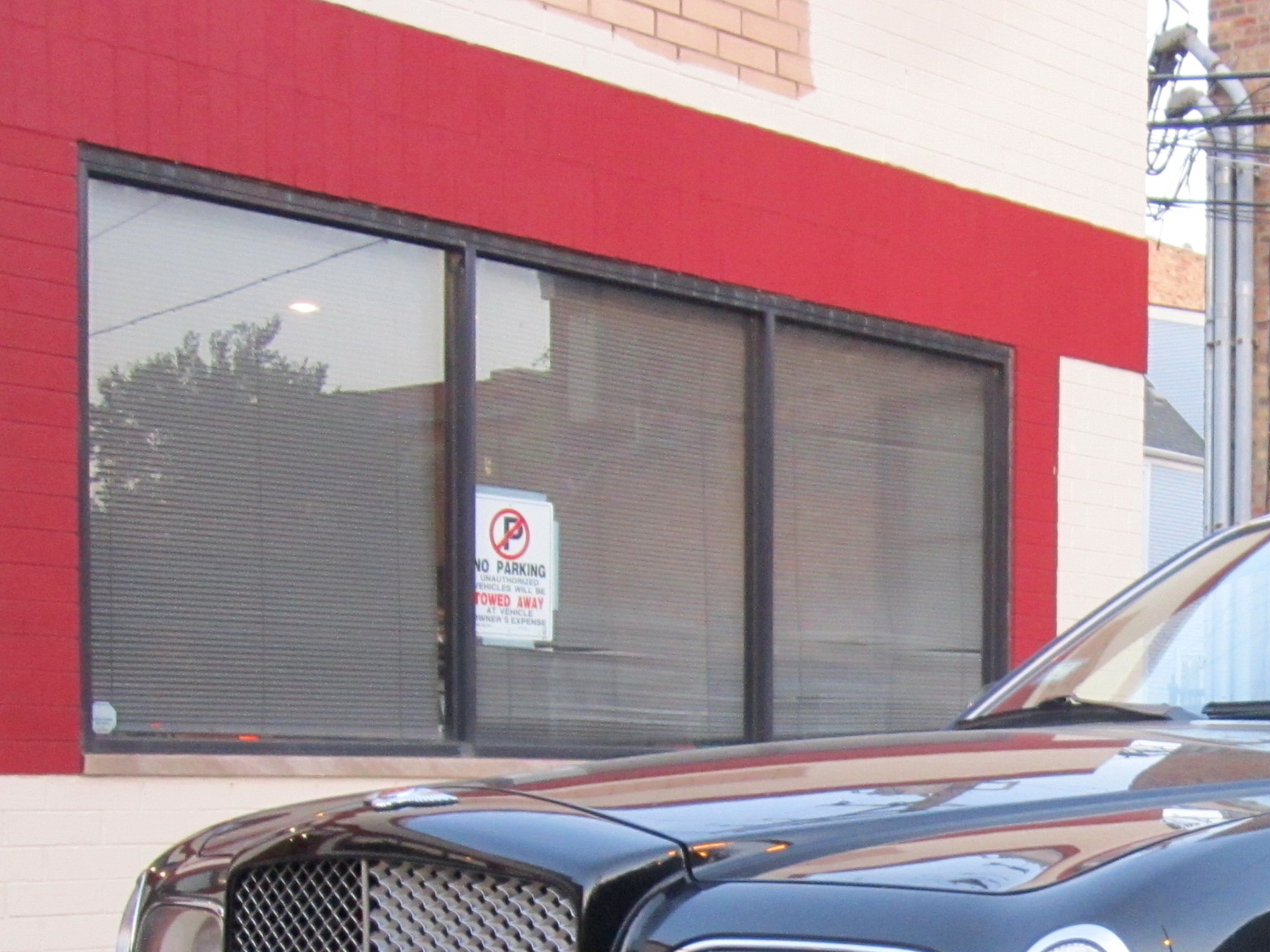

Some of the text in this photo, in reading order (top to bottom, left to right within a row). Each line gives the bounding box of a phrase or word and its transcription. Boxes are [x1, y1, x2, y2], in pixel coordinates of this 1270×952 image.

[475, 558, 546, 578] NO PARKING
[480, 574, 540, 586] UNAUTHORIZED
[514, 585, 533, 594] WILL
[535, 587, 546, 595] BE
[473, 592, 544, 609] TOWED AWAY
[500, 608, 534, 617] VEHICLE
[511, 617, 546, 626] EXPENSE
